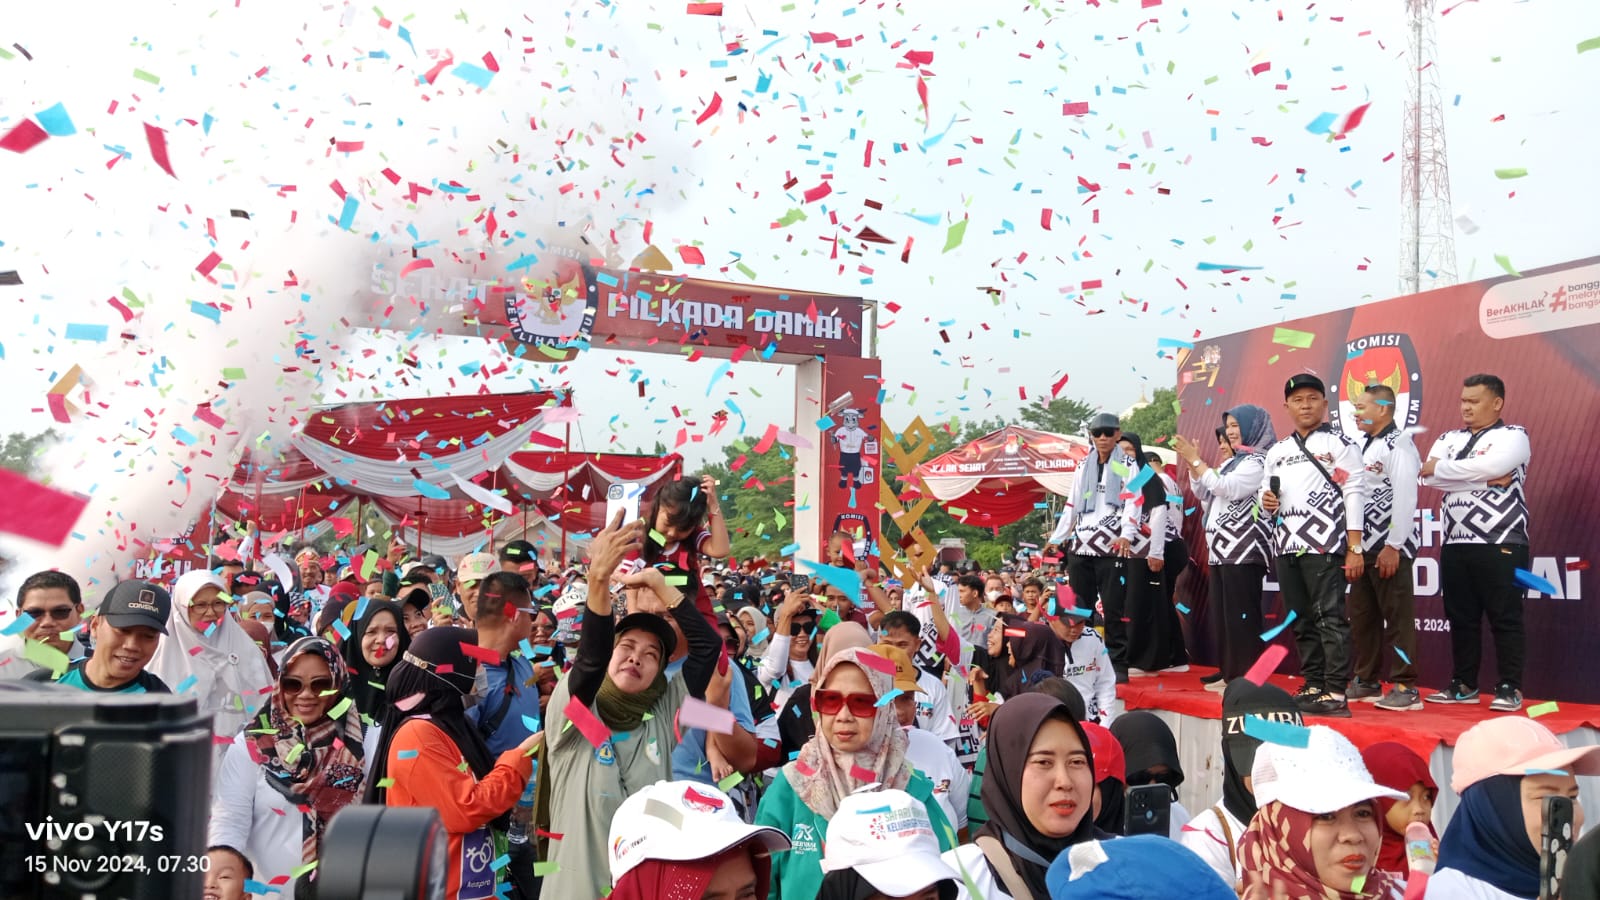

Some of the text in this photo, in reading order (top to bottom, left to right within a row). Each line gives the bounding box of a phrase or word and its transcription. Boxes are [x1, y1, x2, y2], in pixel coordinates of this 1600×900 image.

[1567, 290, 1600, 302] melay
[1486, 300, 1545, 317] BerAKHLAK
[607, 292, 843, 340] PILKADA DAMAI
[1346, 335, 1401, 354] KOMISI
[958, 462, 987, 473] SEHAT
[1035, 459, 1075, 470] PILKADA
[1424, 619, 1450, 632] 2024
